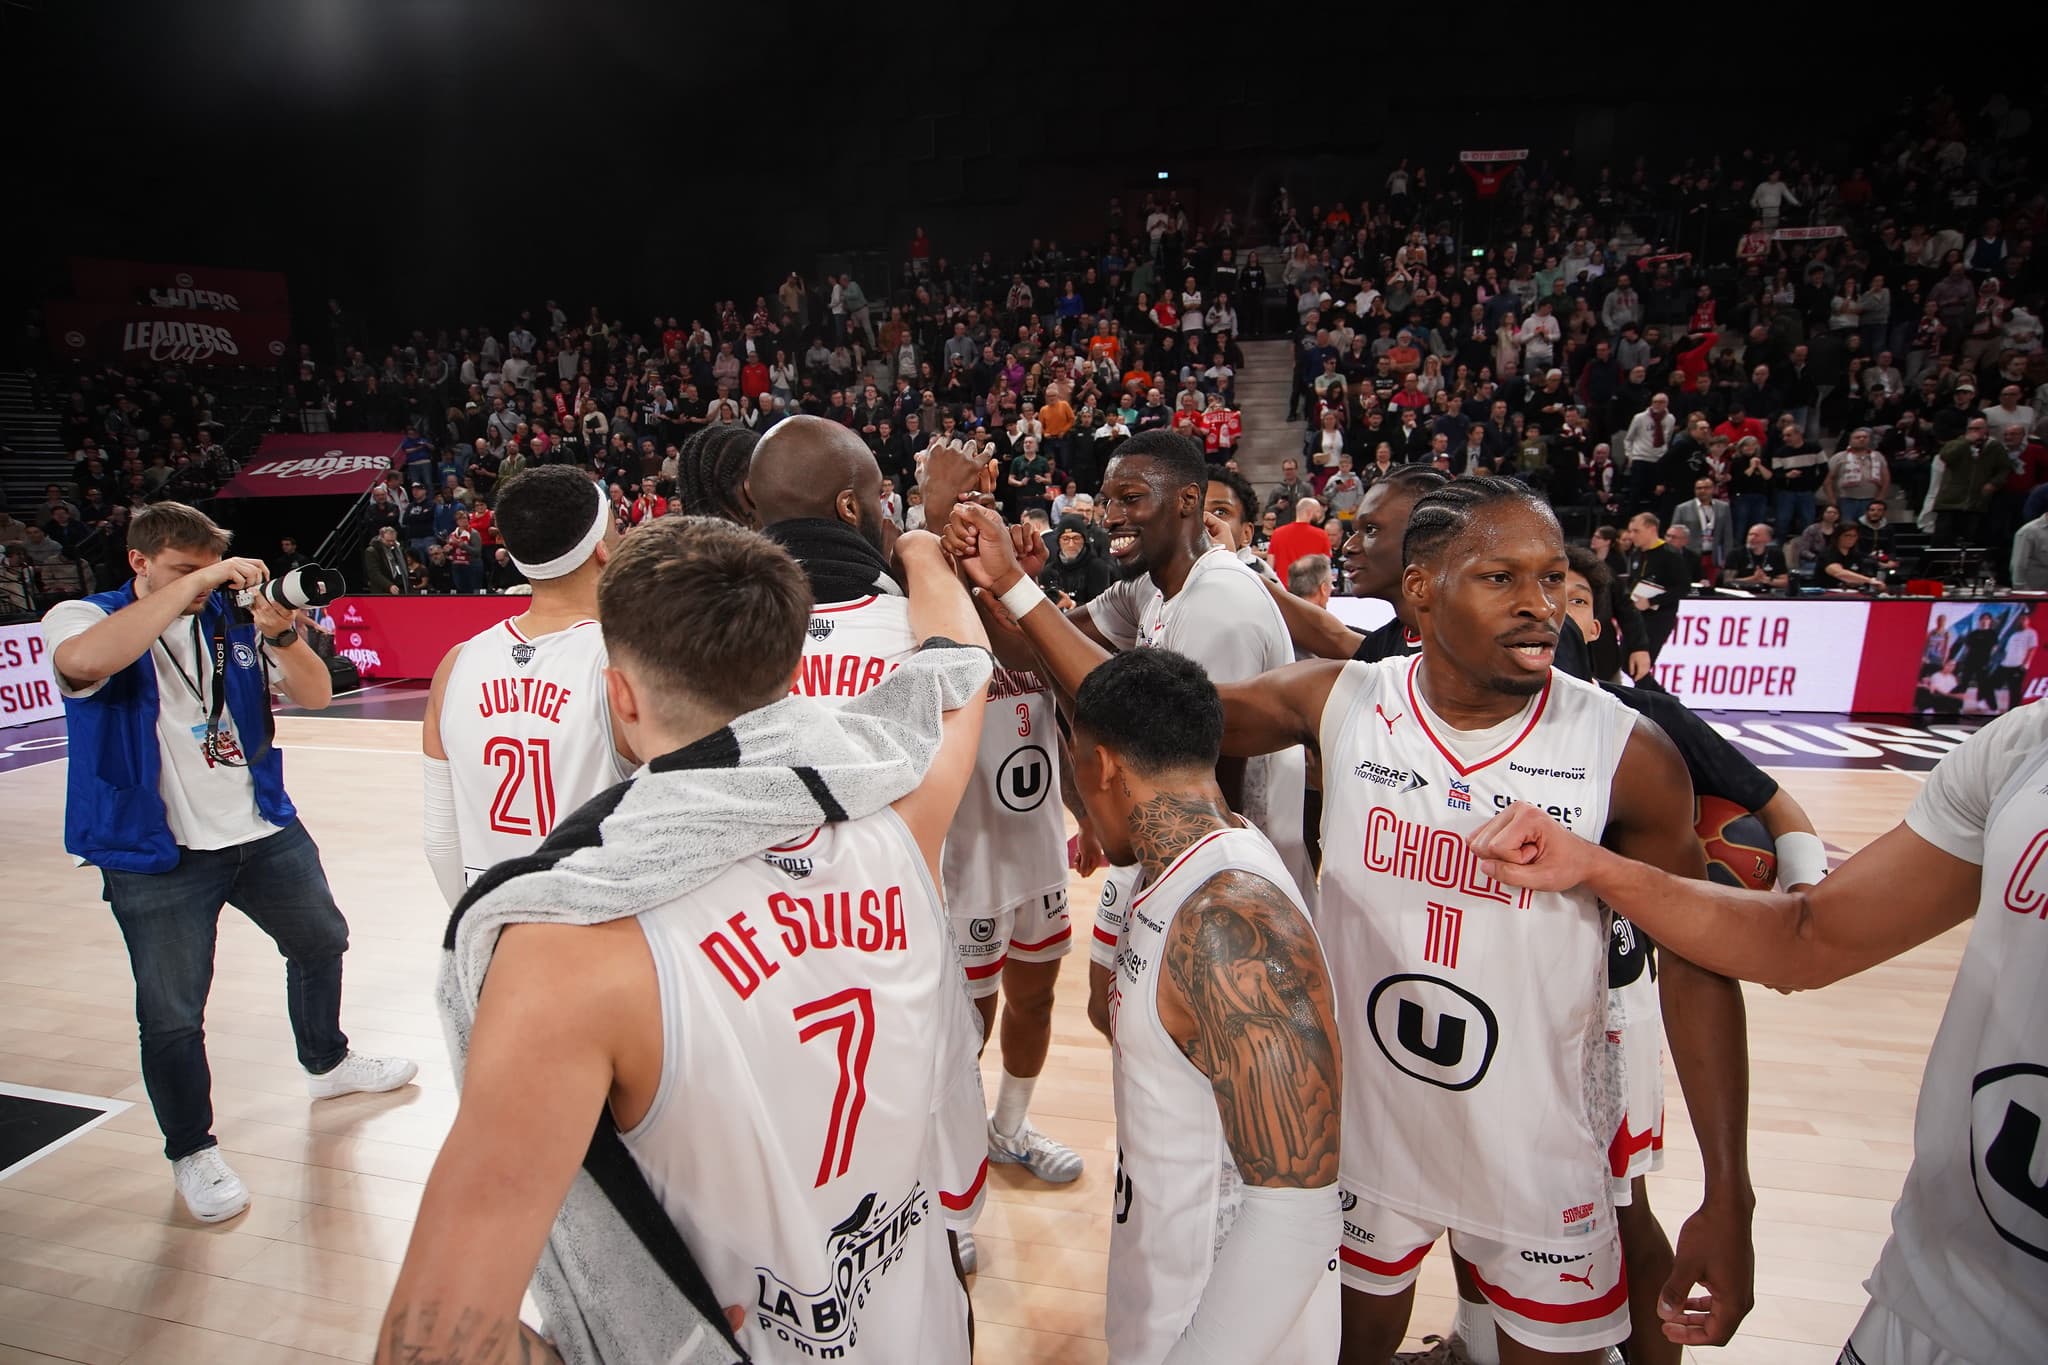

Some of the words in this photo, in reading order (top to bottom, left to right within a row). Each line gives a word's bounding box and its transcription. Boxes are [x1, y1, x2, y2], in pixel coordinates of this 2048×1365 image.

[123, 321, 239, 355] LEADERS
[249, 456, 391, 475] LEADERS
[1719, 616, 1751, 647] DE
[1758, 617, 1789, 647] LA
[215, 643, 225, 676] SONY
[1, 680, 52, 713] SUR
[1692, 665, 1796, 696] HOOPER
[479, 677, 571, 724] JUSTICE
[1016, 703, 1031, 737] 3
[484, 736, 556, 837] 21
[1354, 766, 1398, 788] Transports
[1509, 762, 1586, 780] bouyerleroux
[1447, 798, 1471, 811] ELITE
[1363, 806, 1534, 910] CHOL
[1424, 901, 1463, 969] 11
[699, 911, 780, 1001] DE
[1397, 998, 1466, 1067] U
[793, 987, 875, 1188] 7
[757, 1274, 802, 1327] LA
